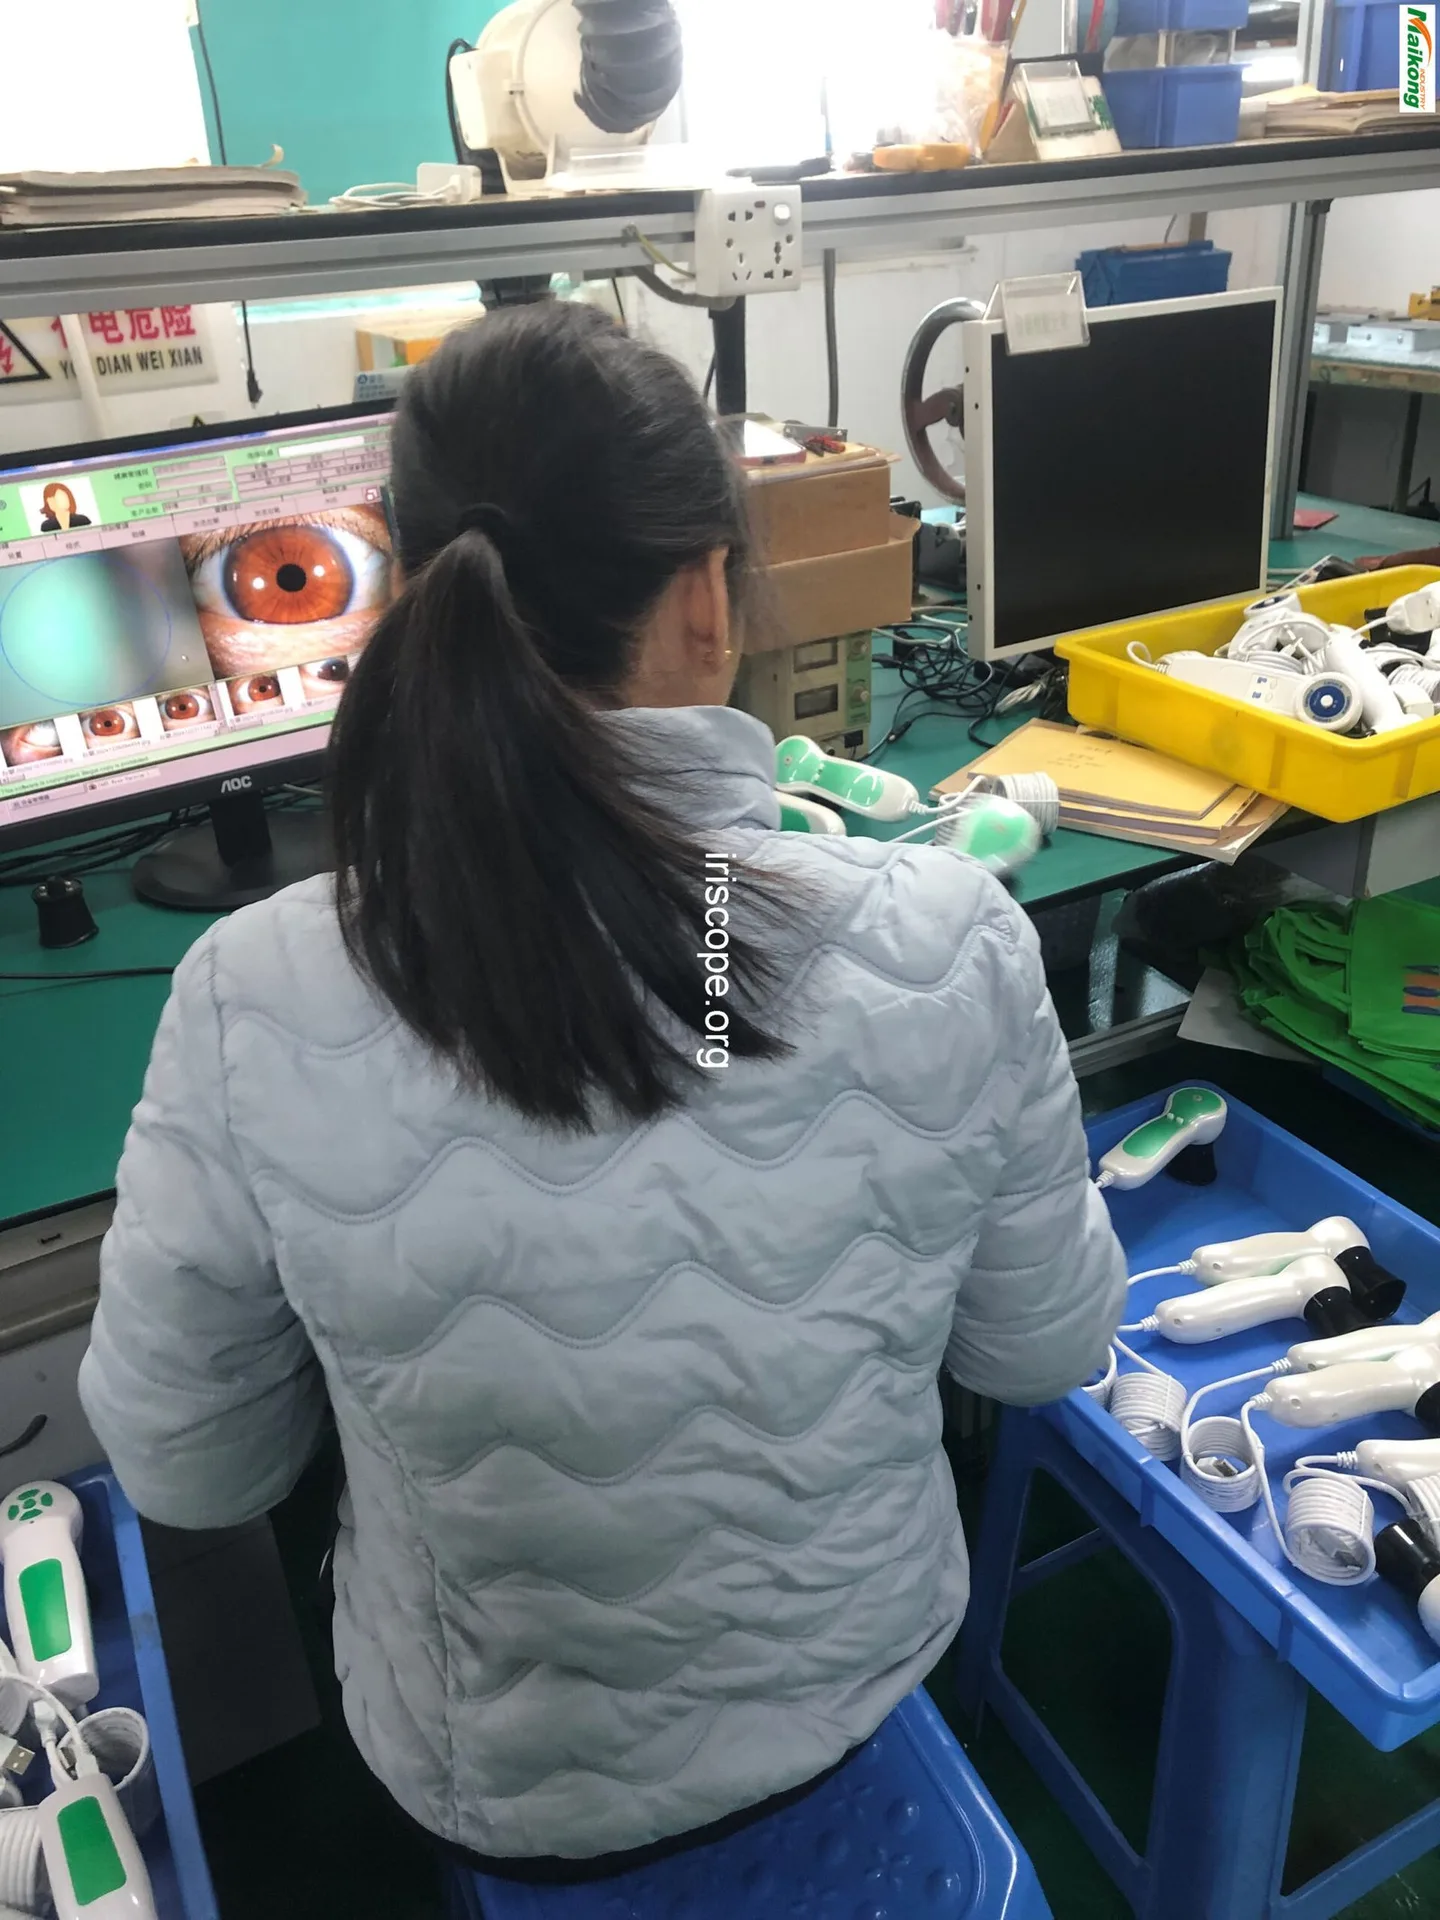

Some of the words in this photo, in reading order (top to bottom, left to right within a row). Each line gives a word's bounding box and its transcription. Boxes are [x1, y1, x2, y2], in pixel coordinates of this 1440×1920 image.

[51, 304, 196, 349] 电危险
[97, 354, 133, 376] DIAN
[137, 350, 165, 371] WEI
[169, 346, 204, 367] XIAN
[221, 775, 252, 794] AOC
